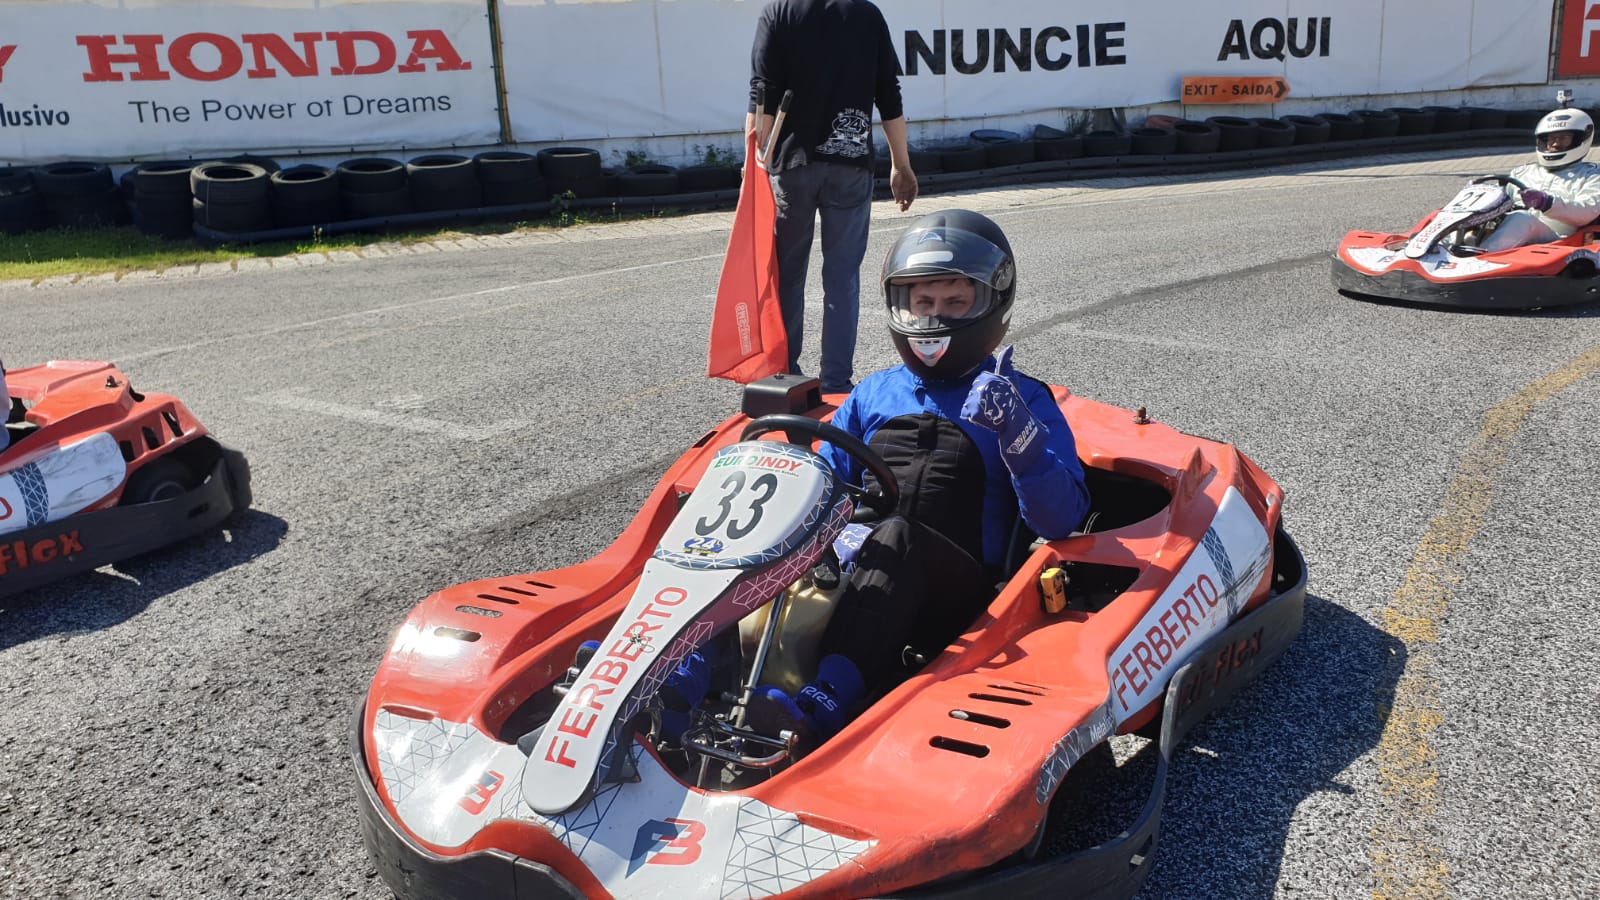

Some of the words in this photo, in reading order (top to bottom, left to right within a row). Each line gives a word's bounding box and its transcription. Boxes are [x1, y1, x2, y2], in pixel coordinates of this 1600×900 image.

[76, 30, 472, 82] HONDA
[896, 22, 1126, 76] NUNCIE
[1217, 17, 1331, 62] AQUI
[128, 100, 190, 123] The
[201, 99, 297, 122] Power
[306, 99, 333, 118] of
[343, 94, 452, 116] Dreams
[1184, 84, 1218, 96] EXIT
[1452, 191, 1487, 208] 21
[695, 470, 778, 540] 33
[1111, 573, 1219, 712] FERBERTO
[545, 586, 688, 769] FERBERTO
[801, 685, 838, 711] RRS
